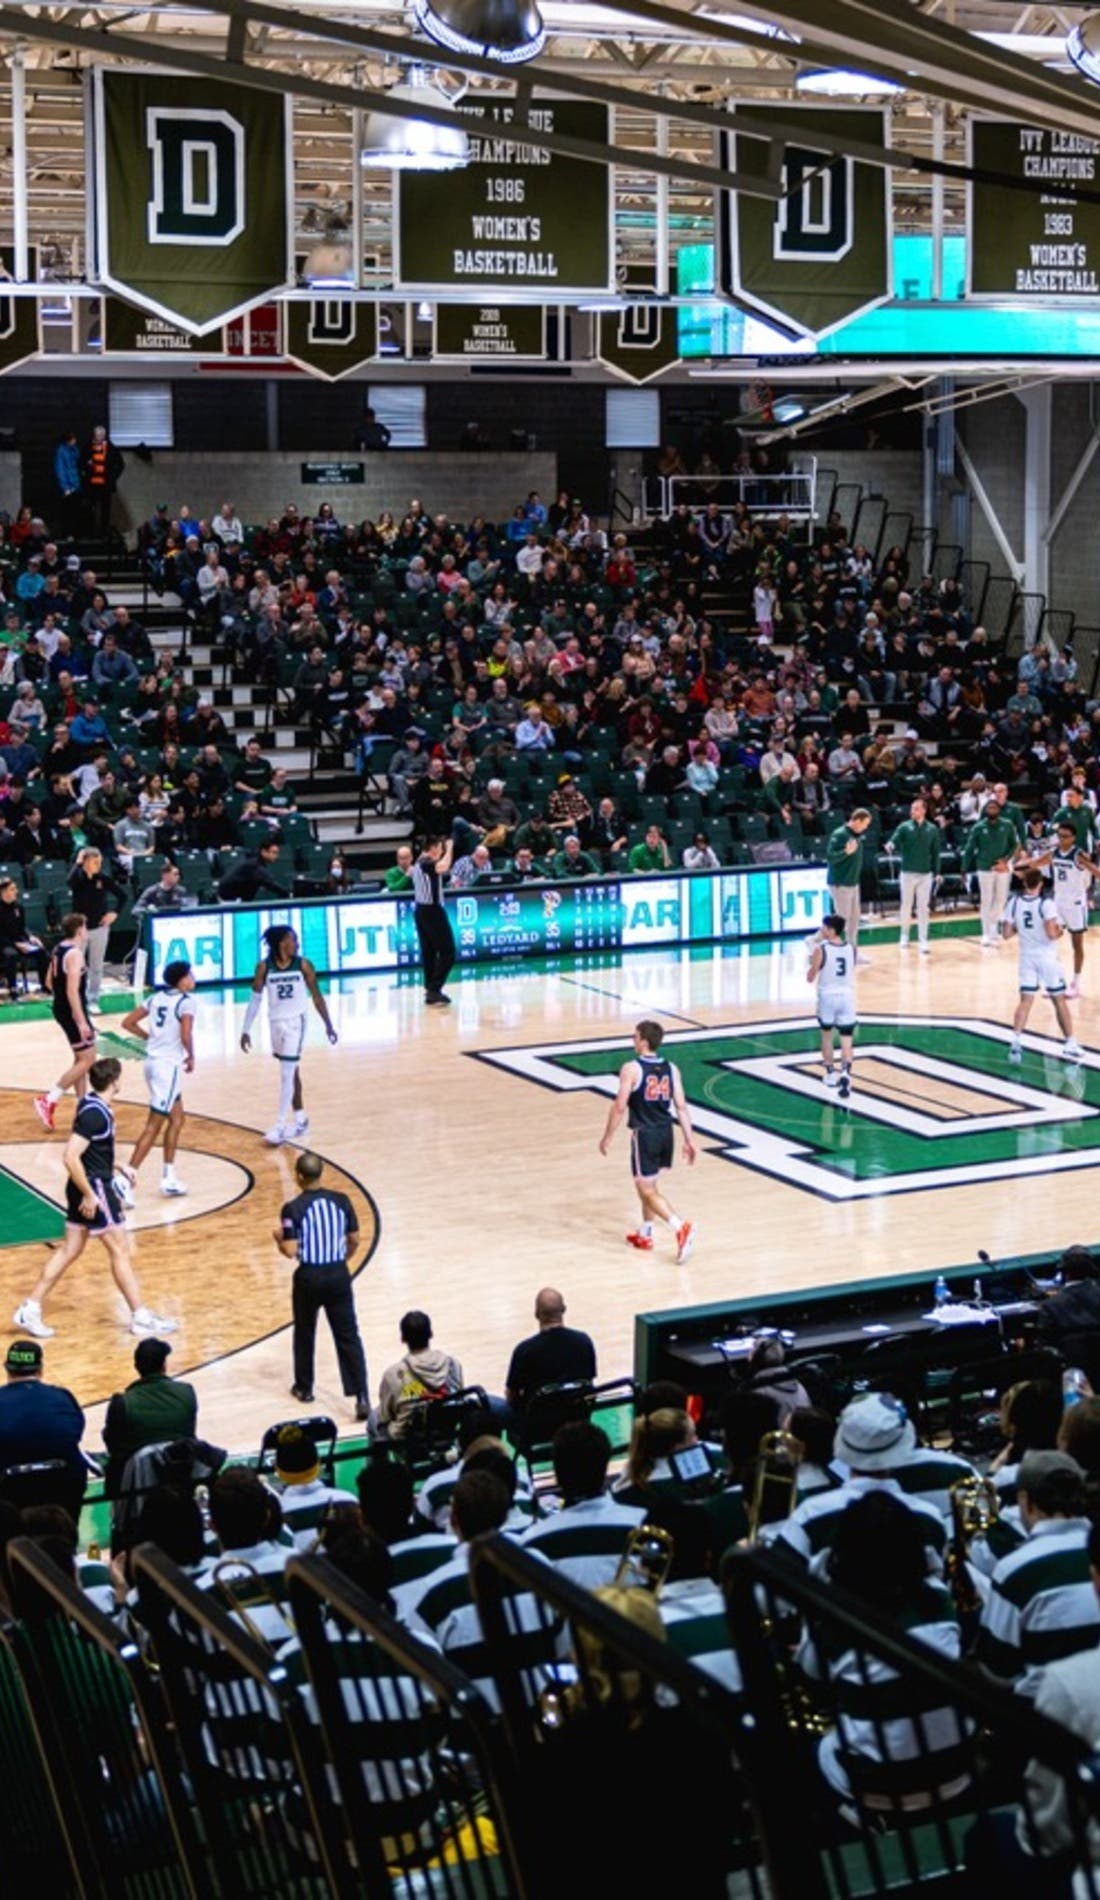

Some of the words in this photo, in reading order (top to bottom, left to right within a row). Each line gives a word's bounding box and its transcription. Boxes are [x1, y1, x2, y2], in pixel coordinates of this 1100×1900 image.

[470, 138, 551, 165] HAMPIONS
[1020, 129, 1044, 151] IVY
[147, 106, 244, 245] D
[1024, 155, 1095, 179] CHAMPIONS
[486, 178, 525, 202] 1986
[773, 143, 853, 262] D
[472, 215, 541, 241] WOMEN'S
[453, 250, 558, 276] BASKETBALL
[1030, 243, 1086, 266] WOMEN'S
[1016, 268, 1099, 292] BASKETBALL
[464, 339, 516, 352] BASKETBALL
[457, 897, 478, 926] D
[1023, 911, 1034, 929] 2
[482, 931, 539, 946] LEDYARD
[836, 957, 847, 976] 3
[277, 984, 294, 1000] 22
[156, 1006, 168, 1027] 5
[644, 1075, 670, 1101] 24
